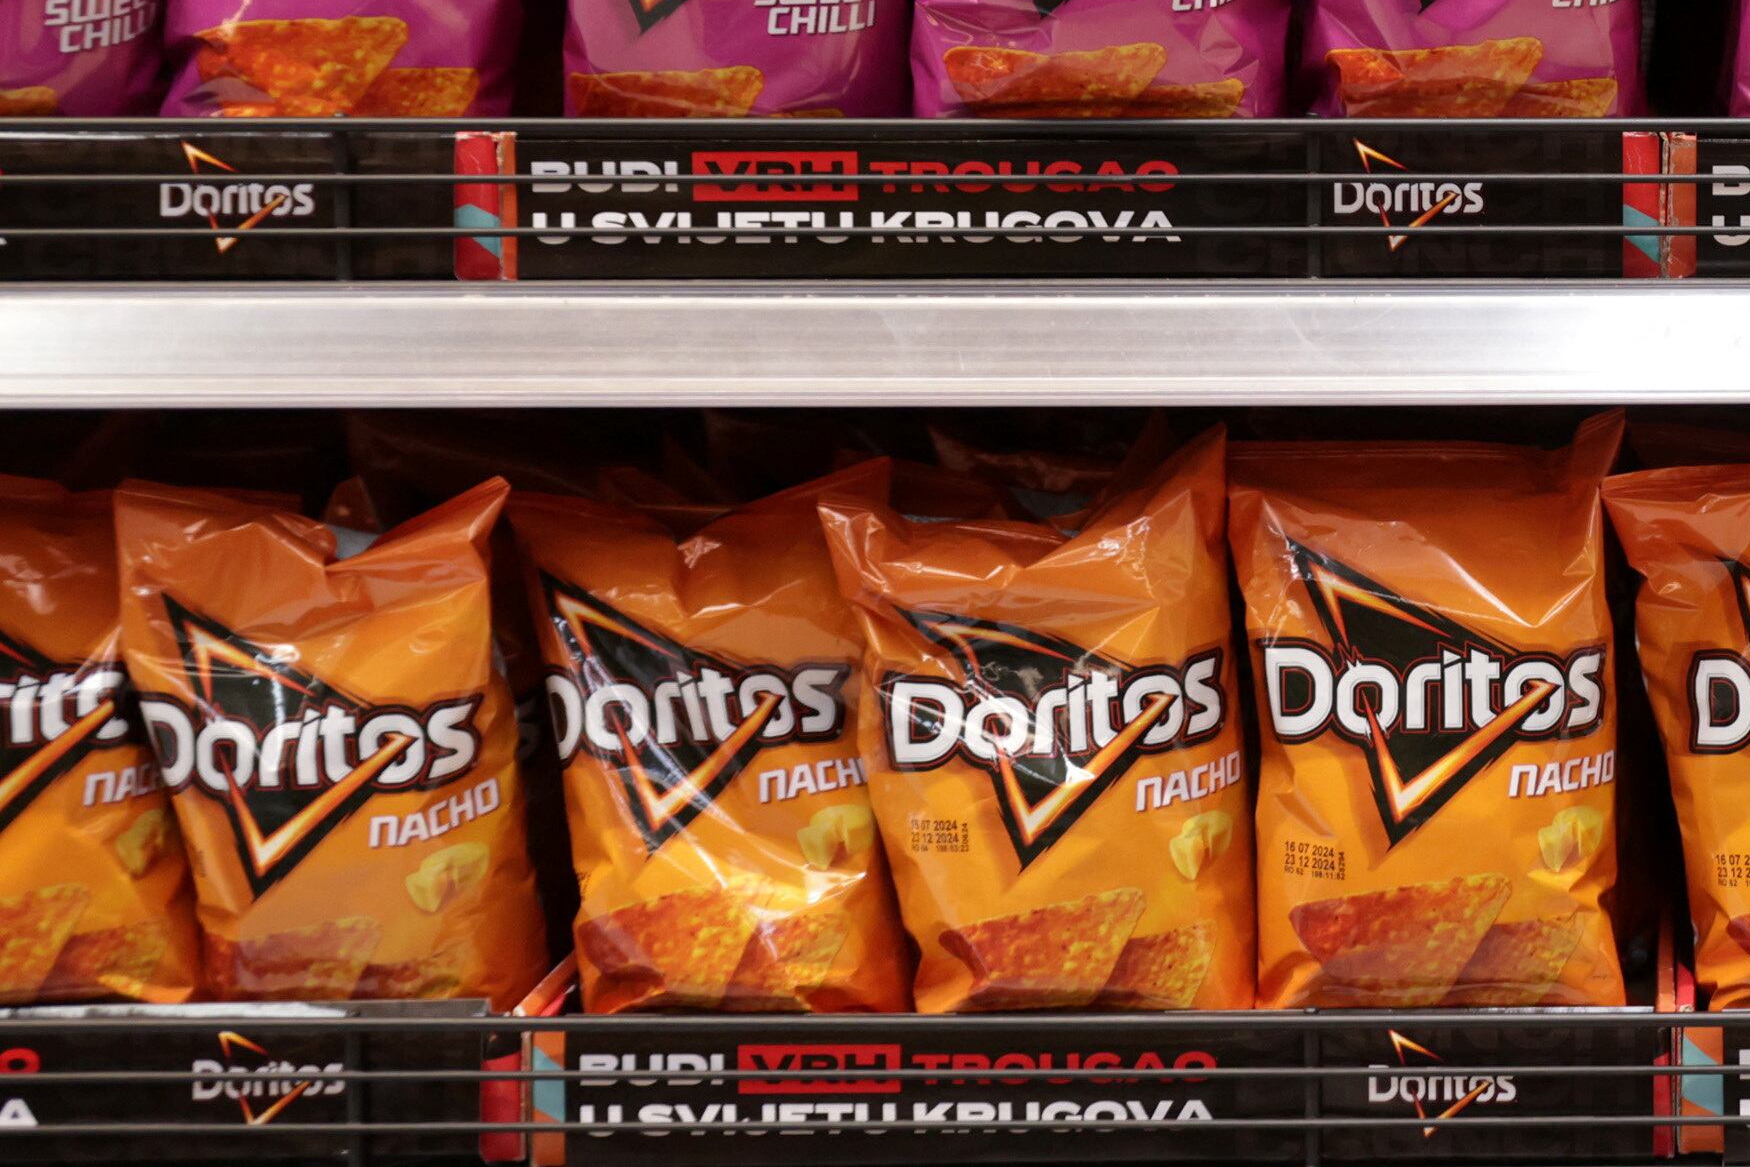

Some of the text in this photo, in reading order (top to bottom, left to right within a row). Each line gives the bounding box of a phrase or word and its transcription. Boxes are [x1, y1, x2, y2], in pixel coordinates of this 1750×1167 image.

[766, 0, 876, 35] CHILLI
[530, 160, 1179, 193] BUDI VRH TROUGAO
[160, 183, 314, 217] Doritos
[1334, 181, 1484, 214] Doritos
[532, 210, 1182, 245] U SVIJETU KRUGOVA
[1267, 645, 1604, 736] Doritos
[894, 657, 1221, 764] Doritos
[143, 700, 482, 792] Doritos
[83, 770, 163, 806] NAC
[1136, 750, 1240, 812] NACHO
[1509, 750, 1614, 797] NACHO
[369, 778, 500, 848] NACHO
[1285, 853, 1335, 870] 23 12 2024
[1312, 844, 1334, 858] 2024
[1717, 866, 1728, 877] 23
[1731, 867, 1742, 878] 12
[192, 1060, 345, 1099] Doritos
[580, 1051, 1217, 1086] BUDI VRH TROUGAO
[1368, 1065, 1516, 1103] Doritos
[580, 1100, 1214, 1136] U SVIJETU KRUGOVA
